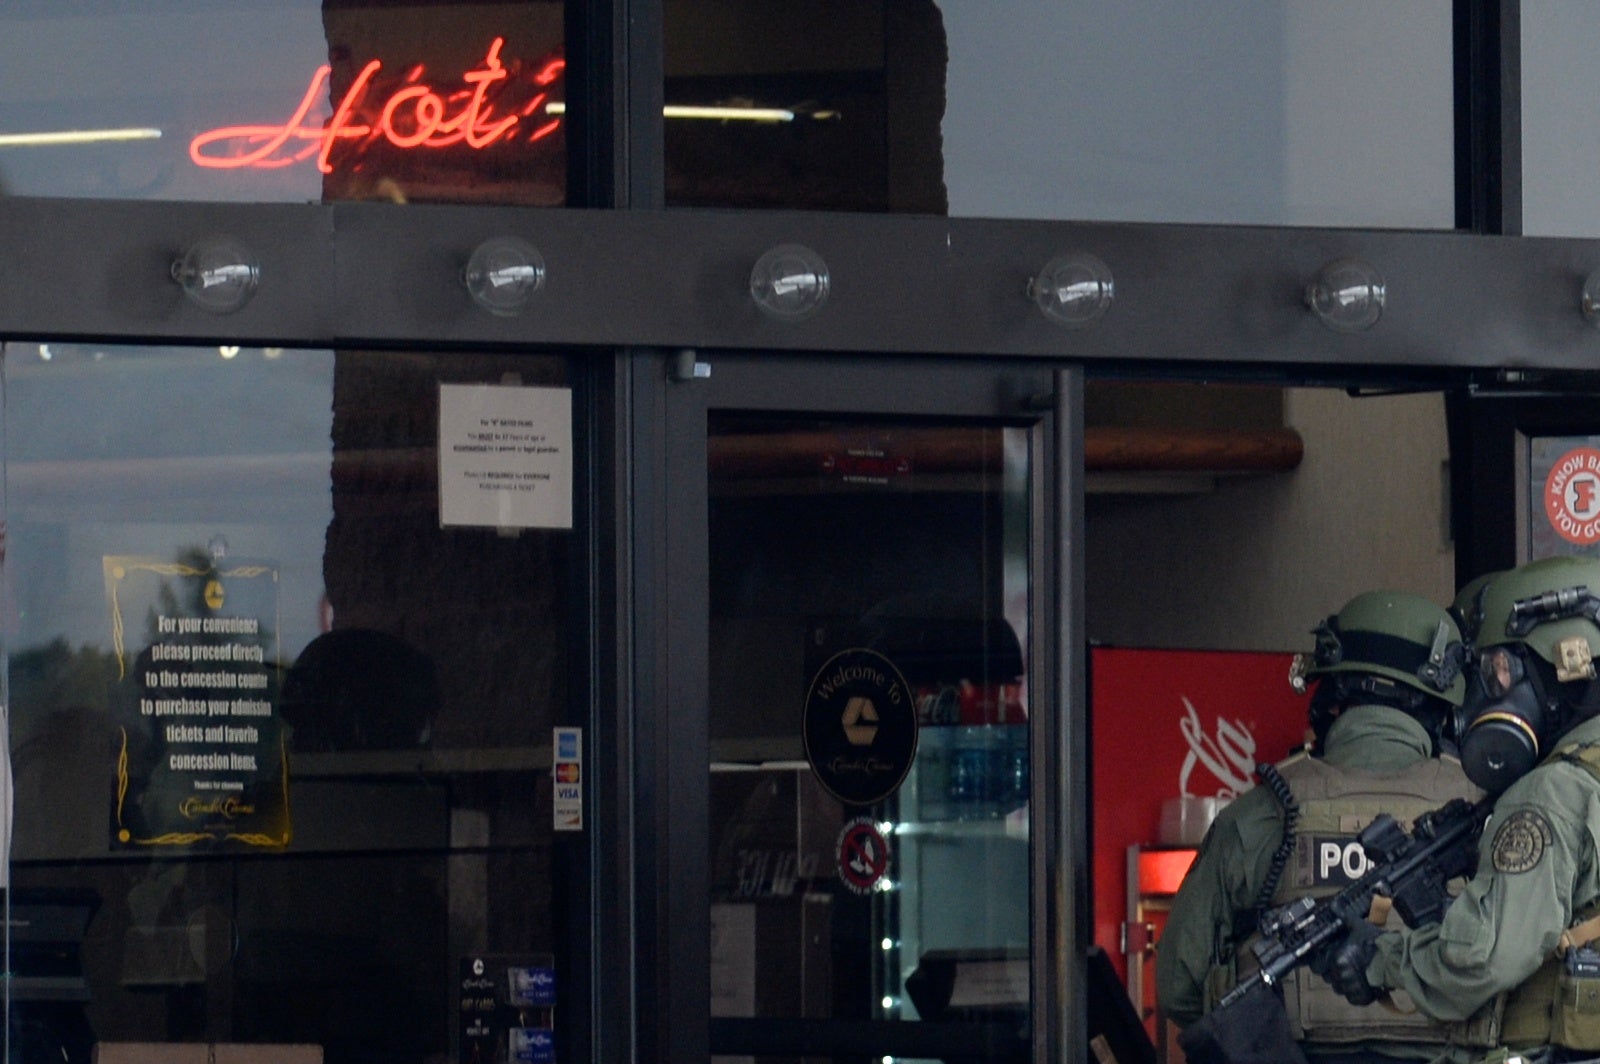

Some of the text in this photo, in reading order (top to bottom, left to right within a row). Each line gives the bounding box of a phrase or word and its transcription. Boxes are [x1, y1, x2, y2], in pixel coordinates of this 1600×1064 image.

[190, 38, 519, 173] Hot
[1551, 455, 1584, 495] KNOW
[1556, 508, 1581, 537] YOU
[158, 615, 258, 635] For your convenience
[152, 643, 263, 663] please proceed directly
[145, 671, 158, 687] to
[160, 670, 179, 688] the
[180, 670, 237, 688] concession
[818, 667, 901, 705] Welcome To
[141, 699, 153, 715] to
[155, 698, 207, 717] purchase
[208, 700, 229, 717] your
[166, 725, 258, 744] tickets and favorite
[170, 752, 258, 771] concession items.
[557, 789, 580, 799] VISA
